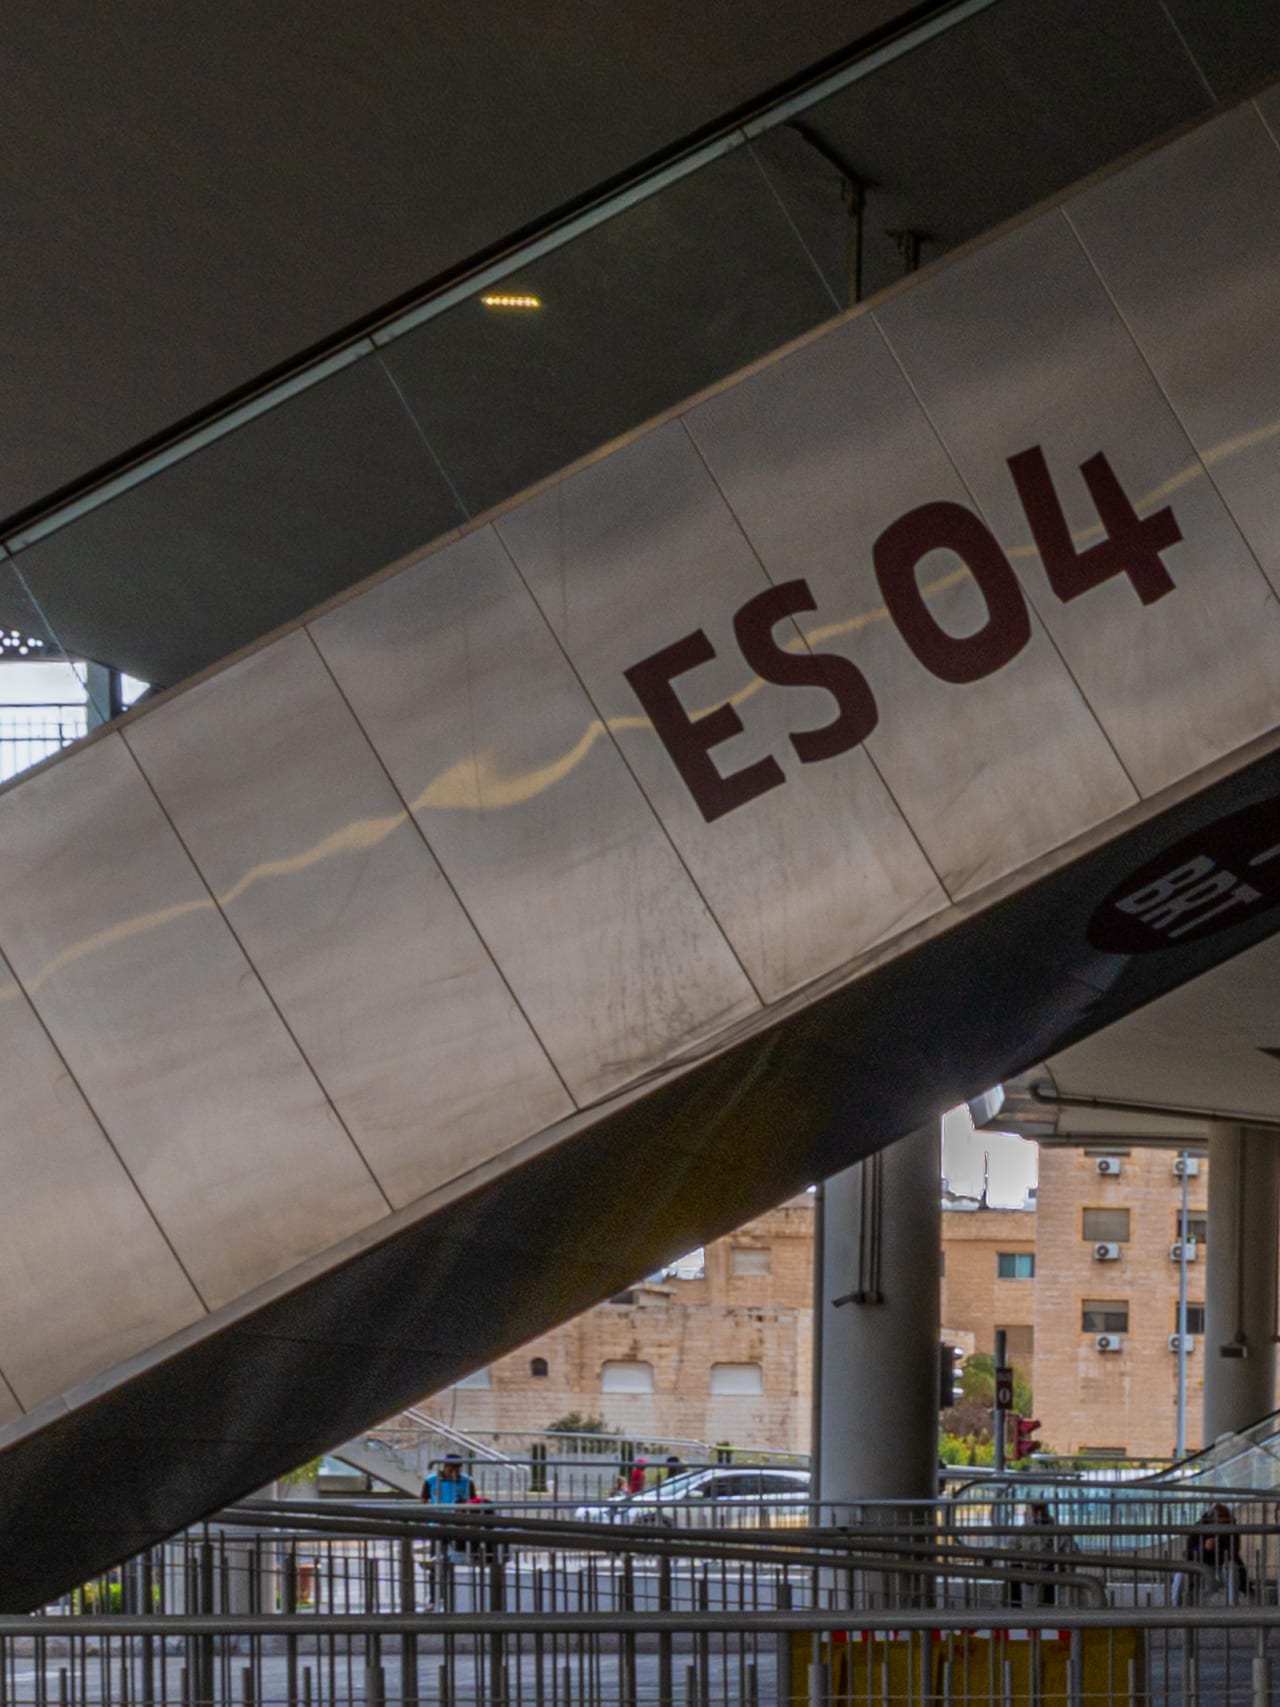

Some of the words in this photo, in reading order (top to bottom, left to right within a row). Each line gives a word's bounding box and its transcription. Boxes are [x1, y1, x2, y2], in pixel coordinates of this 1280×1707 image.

[623, 578, 879, 823] ES
[871, 445, 1184, 685] 04
[1114, 854, 1263, 939] BRT
